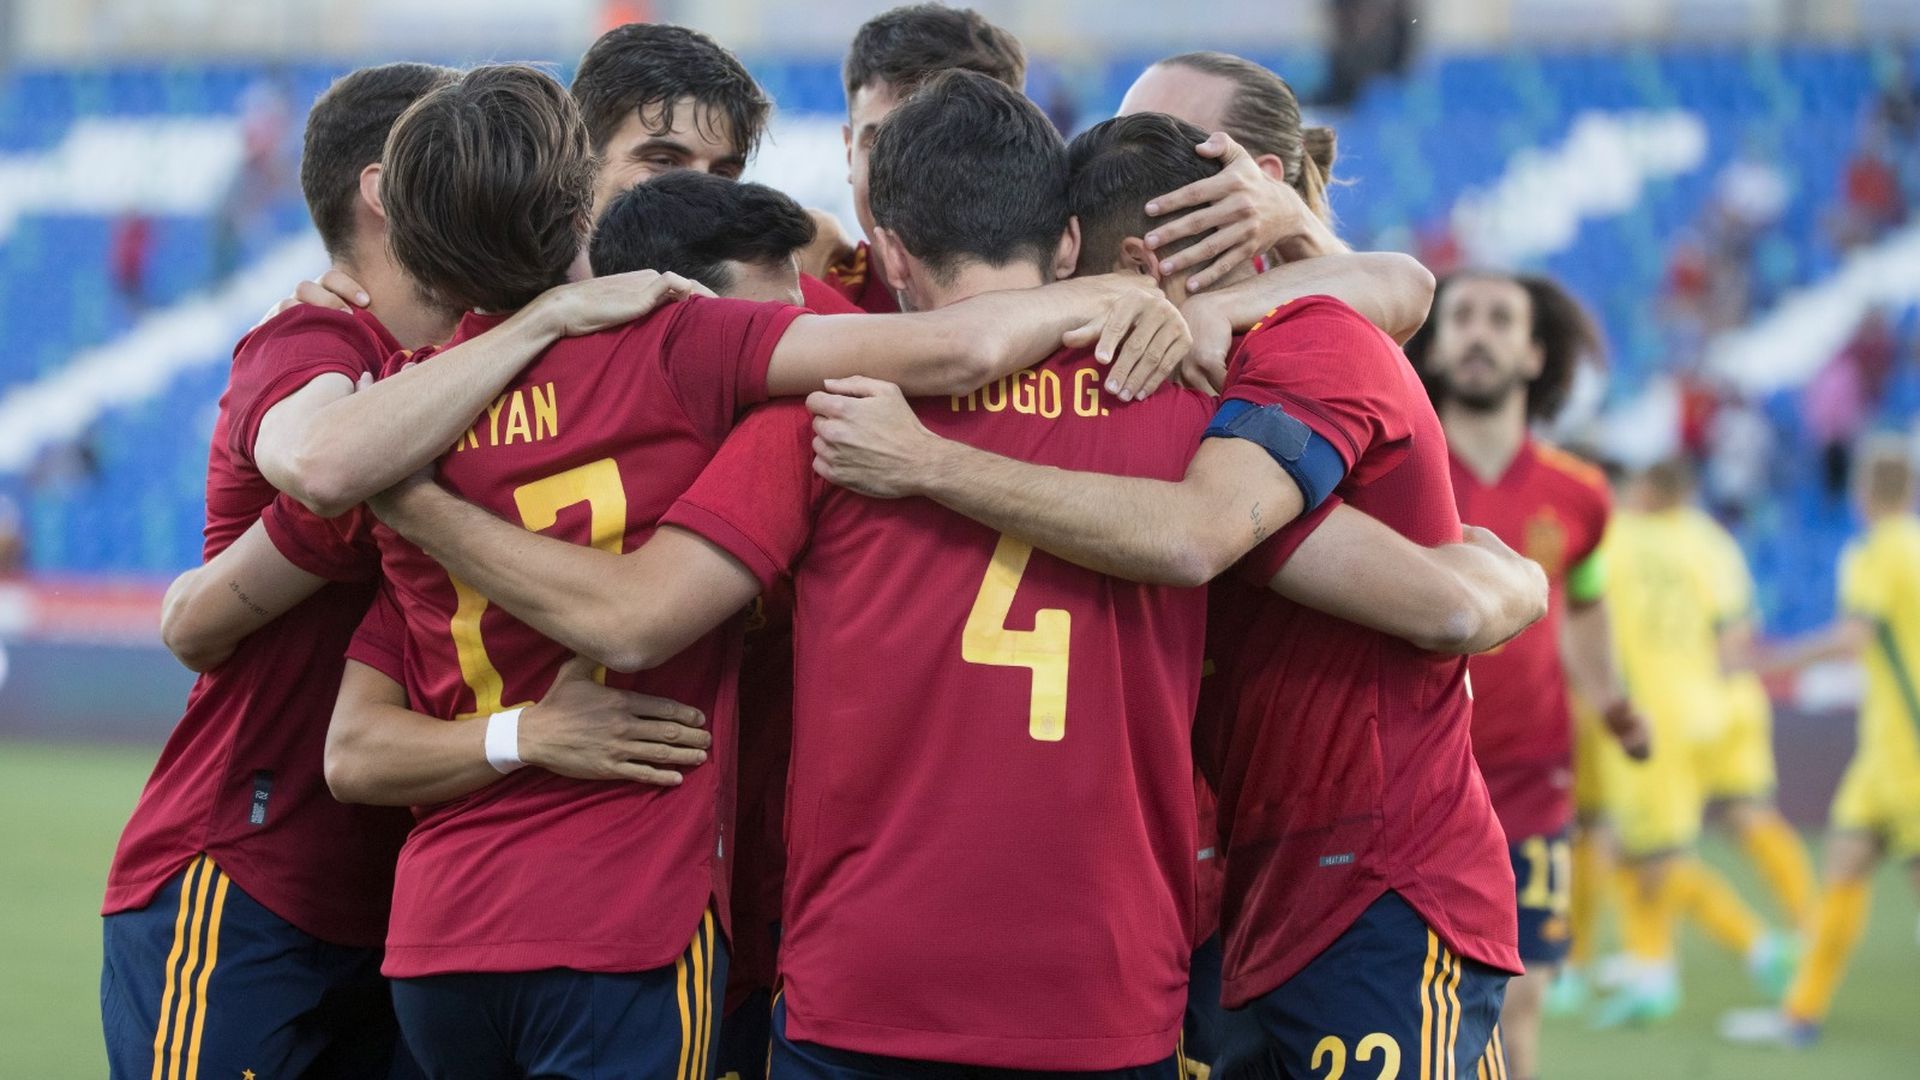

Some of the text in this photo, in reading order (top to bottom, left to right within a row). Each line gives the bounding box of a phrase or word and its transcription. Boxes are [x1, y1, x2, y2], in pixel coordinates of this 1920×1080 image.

[1074, 367, 1109, 417] G.
[961, 532, 1072, 742] 4
[1519, 835, 1571, 912] 11
[1310, 1032, 1402, 1080] 22
